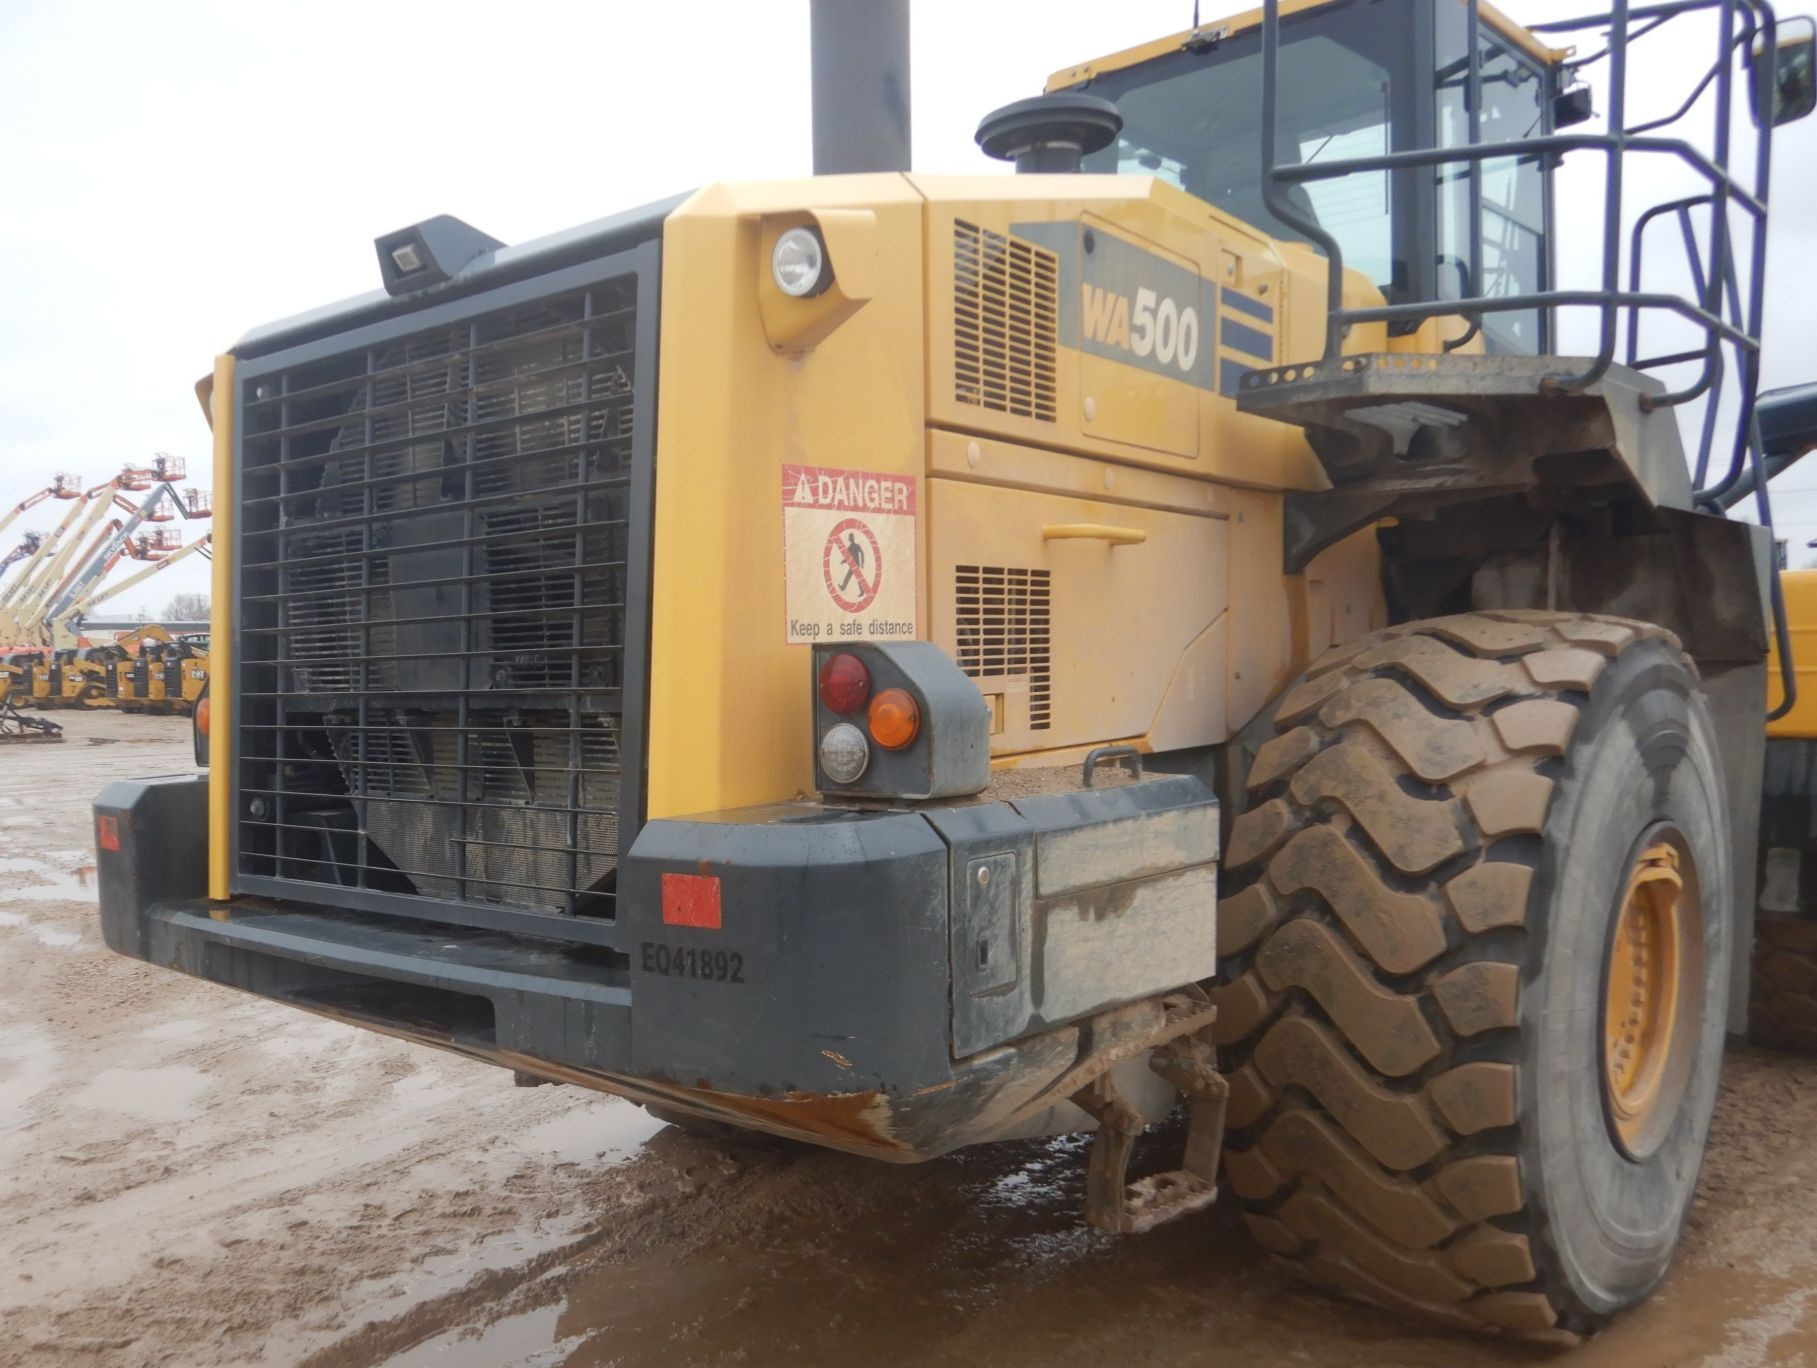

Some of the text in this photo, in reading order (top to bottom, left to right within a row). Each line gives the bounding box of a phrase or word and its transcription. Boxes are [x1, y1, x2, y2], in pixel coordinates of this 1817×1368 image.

[1082, 282, 1199, 372] WA500
[818, 474, 909, 510] DANGER
[790, 618, 914, 640] Keep a safe distance
